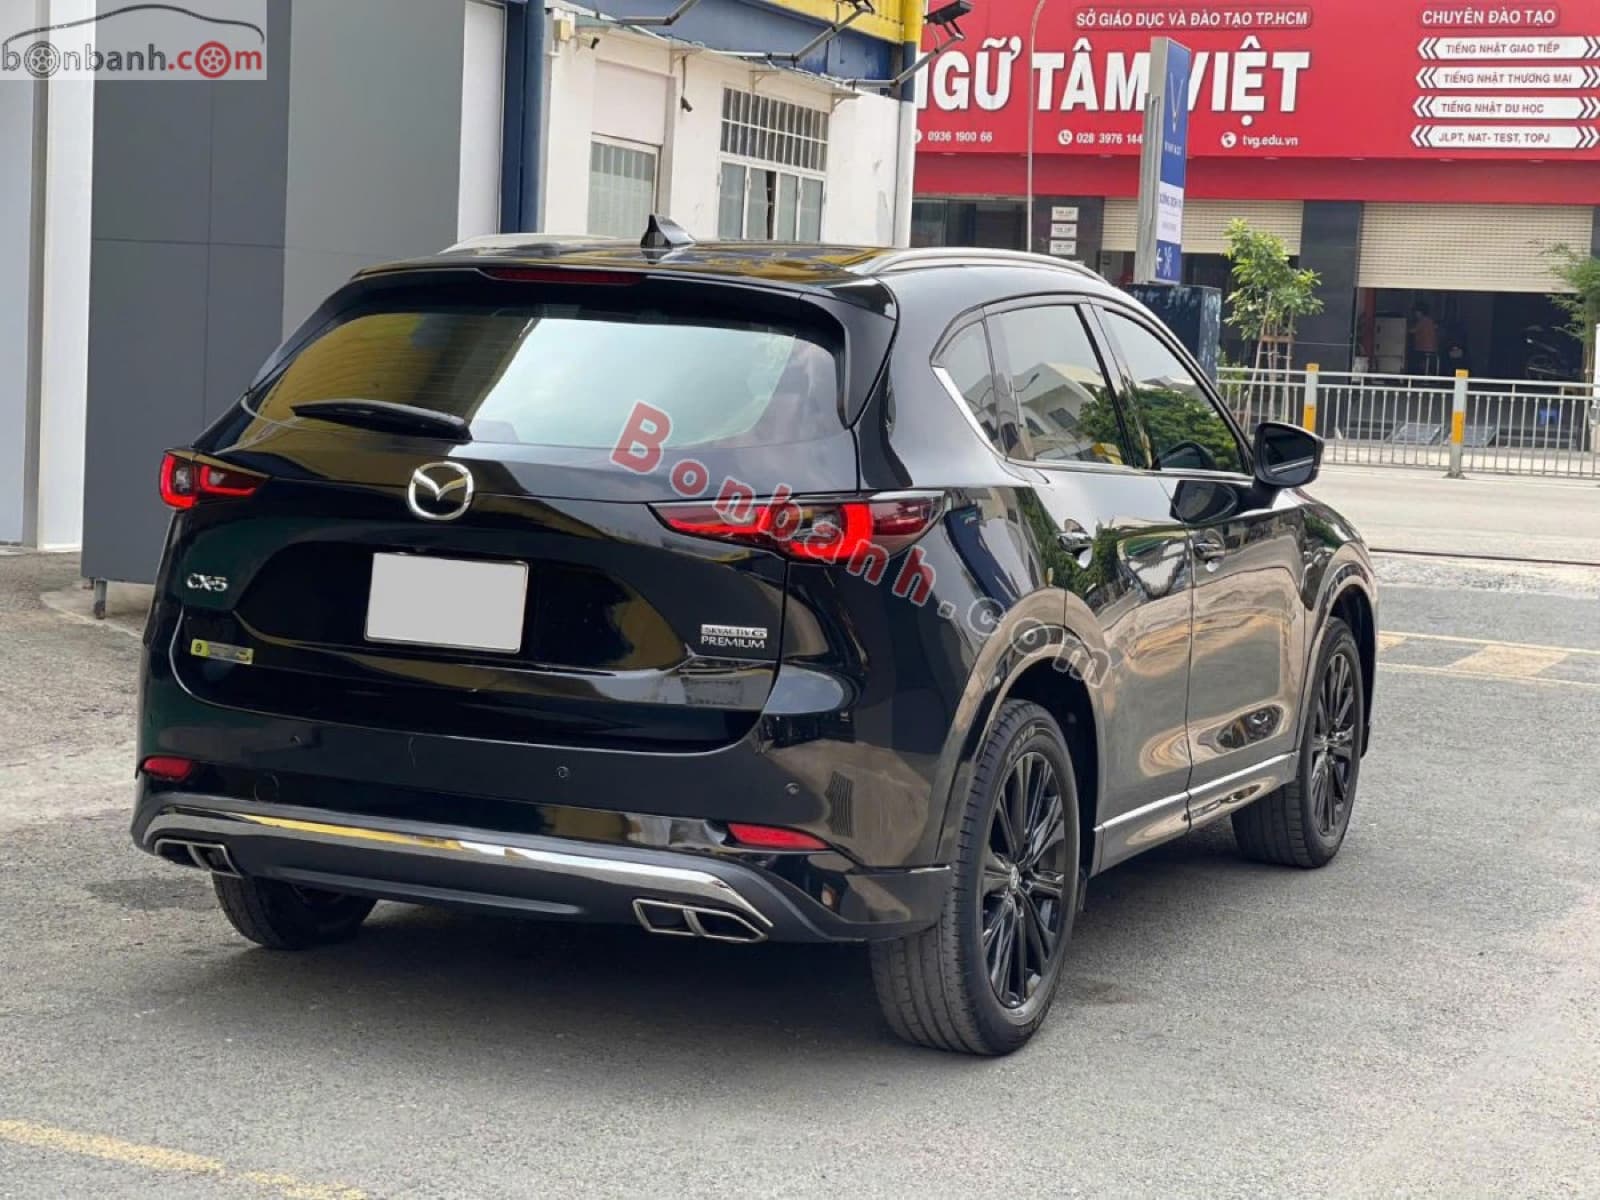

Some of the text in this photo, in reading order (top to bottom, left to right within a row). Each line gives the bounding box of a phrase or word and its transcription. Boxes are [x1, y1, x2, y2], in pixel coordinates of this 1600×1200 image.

[1076, 8, 1308, 28] SỞ GIÁO DỤC VÀ ĐÀO TẠO TP.HCM
[1422, 7, 1556, 26] CHUYÊN ĐÀO TẠO
[1446, 40, 1560, 55] TIẾNG NHẬT GIAO TIẾP
[1032, 37, 1149, 111] TÂM
[1444, 70, 1474, 84] TIẾNG
[1477, 71, 1504, 85] NHẬT
[1441, 100, 1544, 115] TIẾNG NHẬT DU HỌC
[927, 131, 993, 142] 0936 1900 66
[1076, 132, 1095, 144] 028
[1098, 133, 1123, 144] 3976
[1242, 134, 1298, 148] tvg.edu.vn
[1438, 133, 1465, 144] JLPT,
[1494, 133, 1522, 144] TEST,
[1524, 133, 1551, 143] TOPJ
[186, 572, 228, 592] CX-5
[701, 635, 765, 648] PREMIUM
